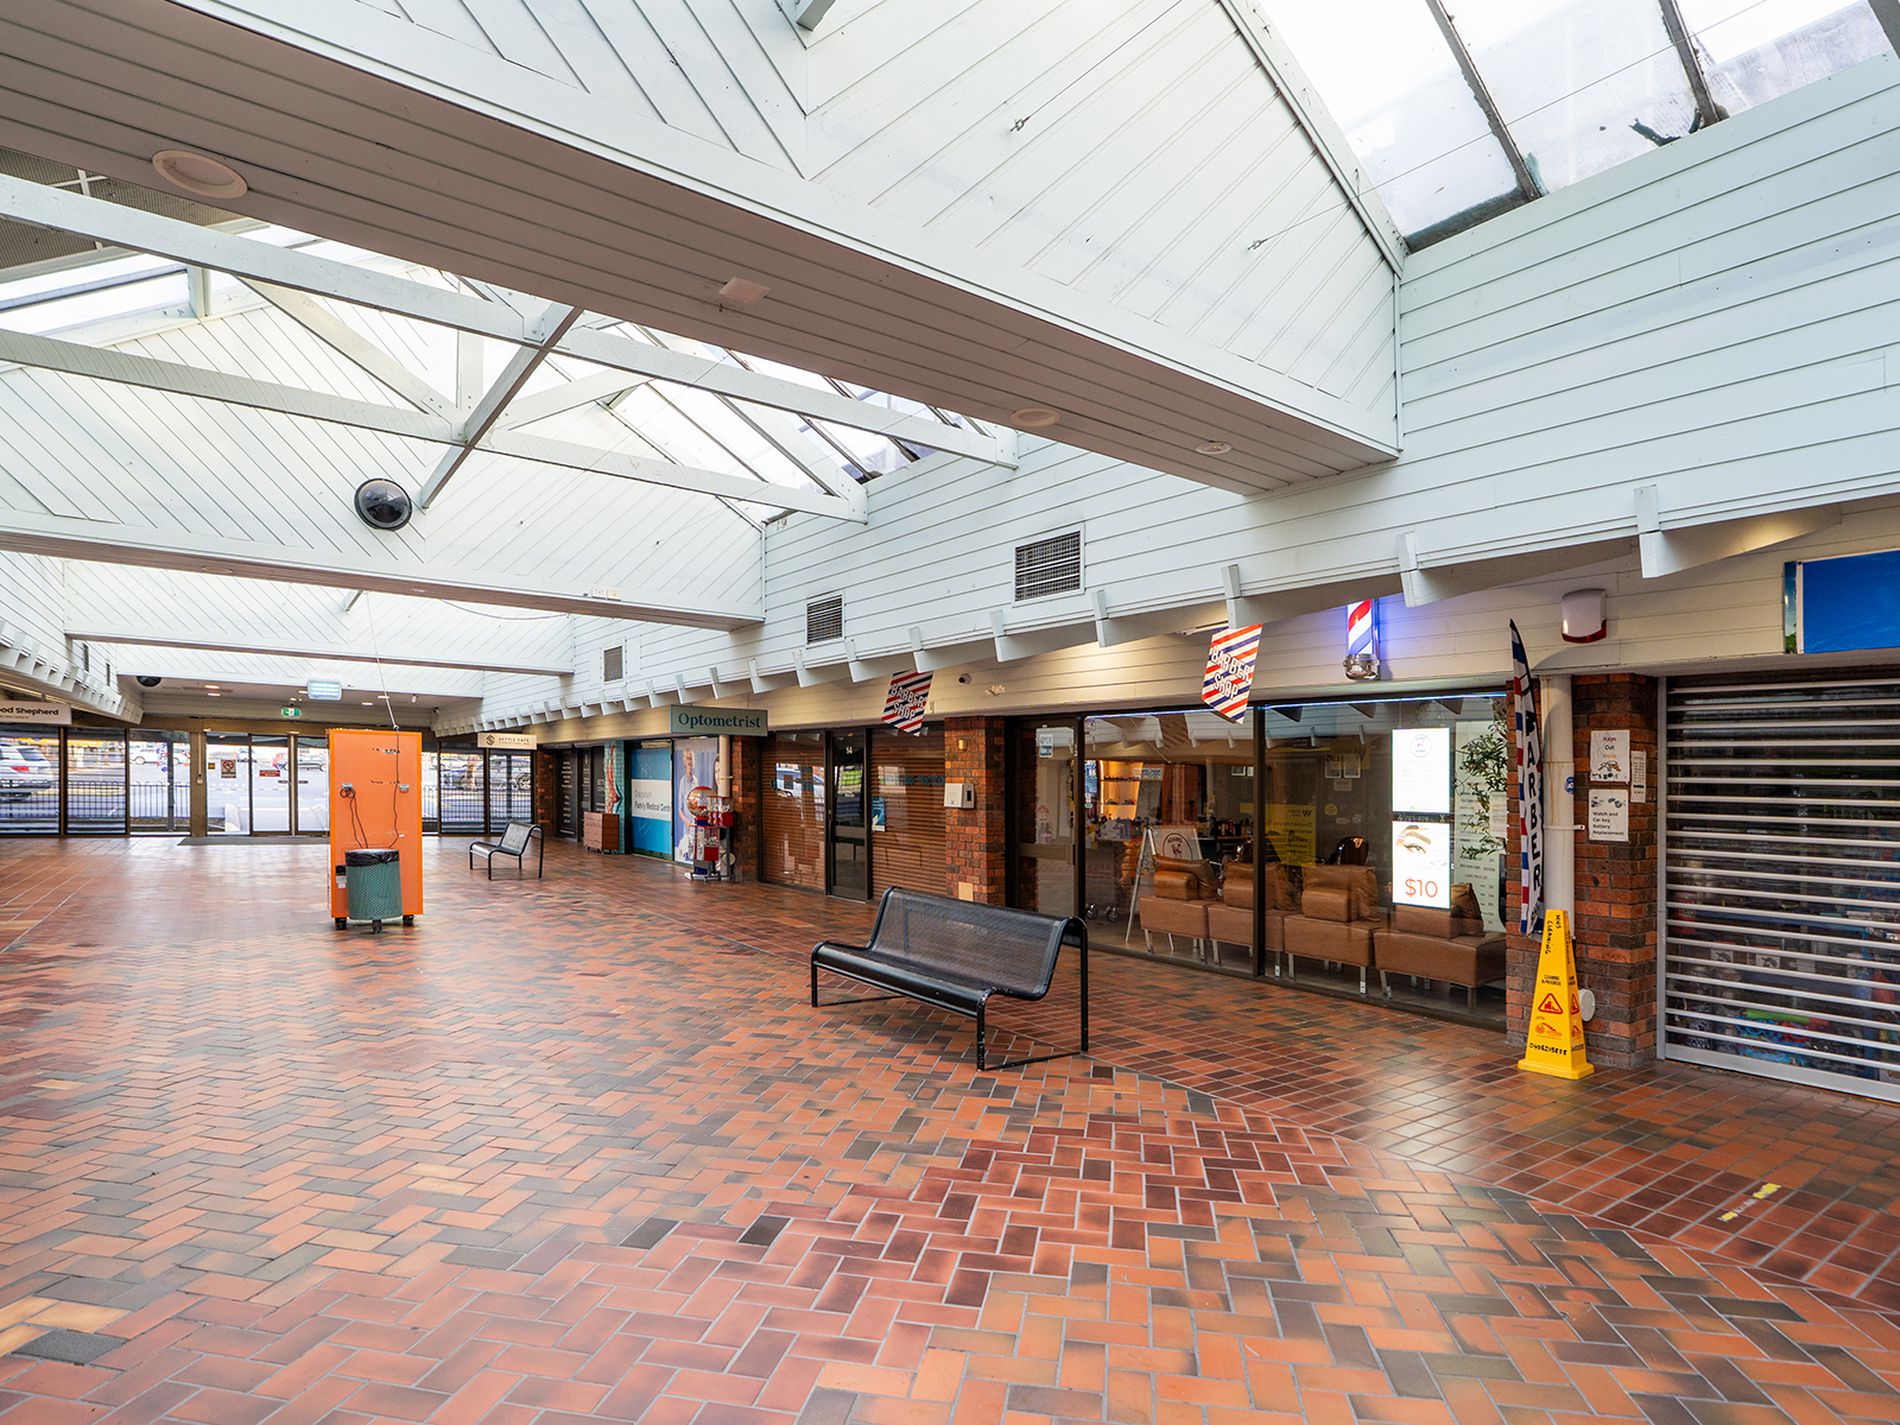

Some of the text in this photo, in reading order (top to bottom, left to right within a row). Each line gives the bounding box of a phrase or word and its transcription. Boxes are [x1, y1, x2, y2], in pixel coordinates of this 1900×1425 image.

[1209, 645, 1251, 682] BARBER
[889, 683, 924, 709] BARBER
[1214, 673, 1239, 700] SHOP
[16, 707, 59, 716] Shepherd
[678, 712, 761, 729] Optometrist
[893, 701, 916, 720] SHOP
[1405, 877, 1438, 898] $10
